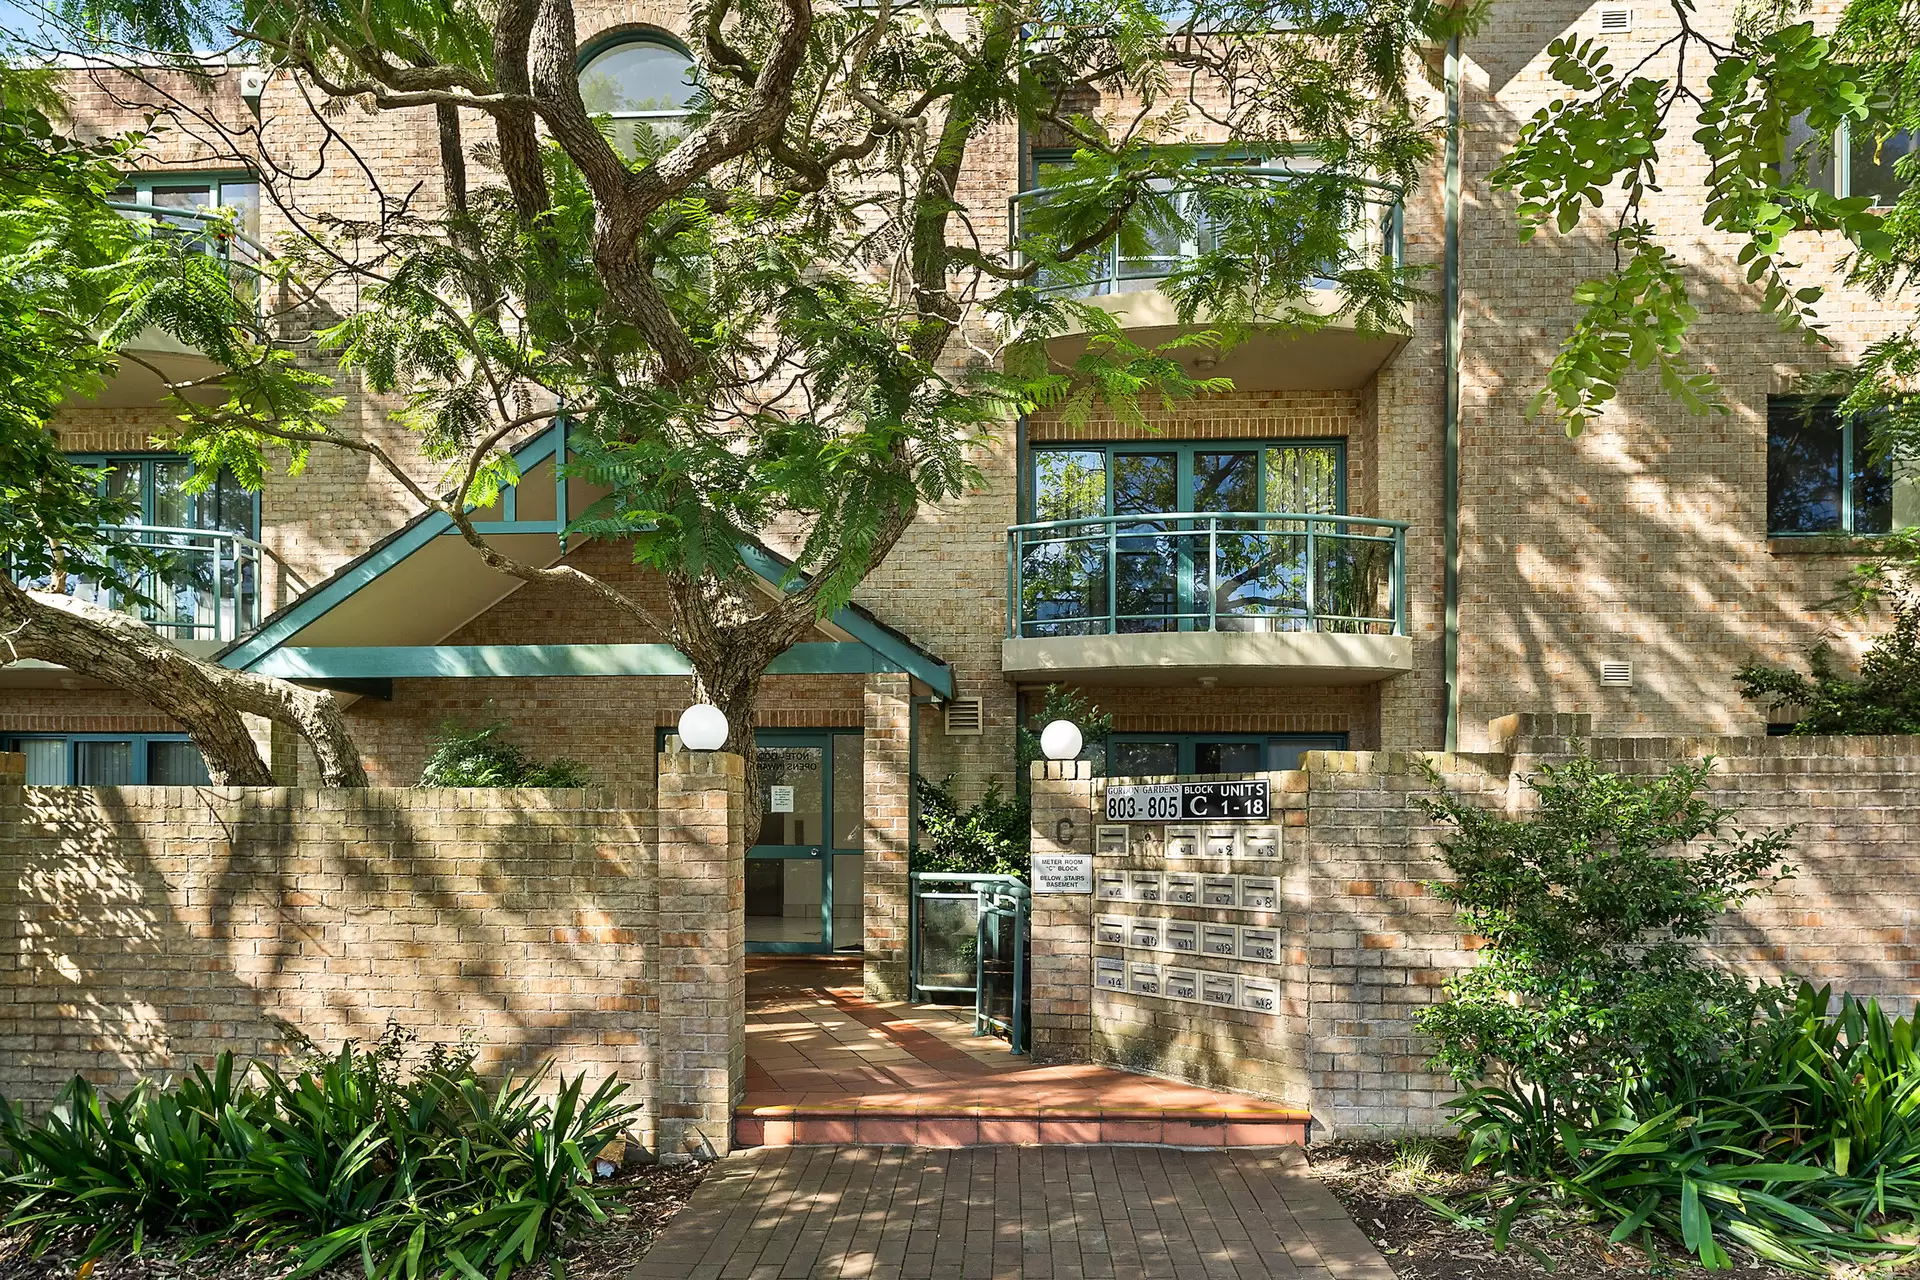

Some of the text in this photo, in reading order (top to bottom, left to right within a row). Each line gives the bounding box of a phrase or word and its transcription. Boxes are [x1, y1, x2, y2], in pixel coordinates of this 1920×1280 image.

[1108, 785, 1180, 795] GORDON GARDENS
[1184, 783, 1264, 797] BLOCK UNITS
[1189, 796, 1208, 816] C
[1057, 817, 1074, 845] C
[1225, 845, 1233, 857] 2
[1223, 894, 1232, 905] 7
[1265, 896, 1273, 908] 8
